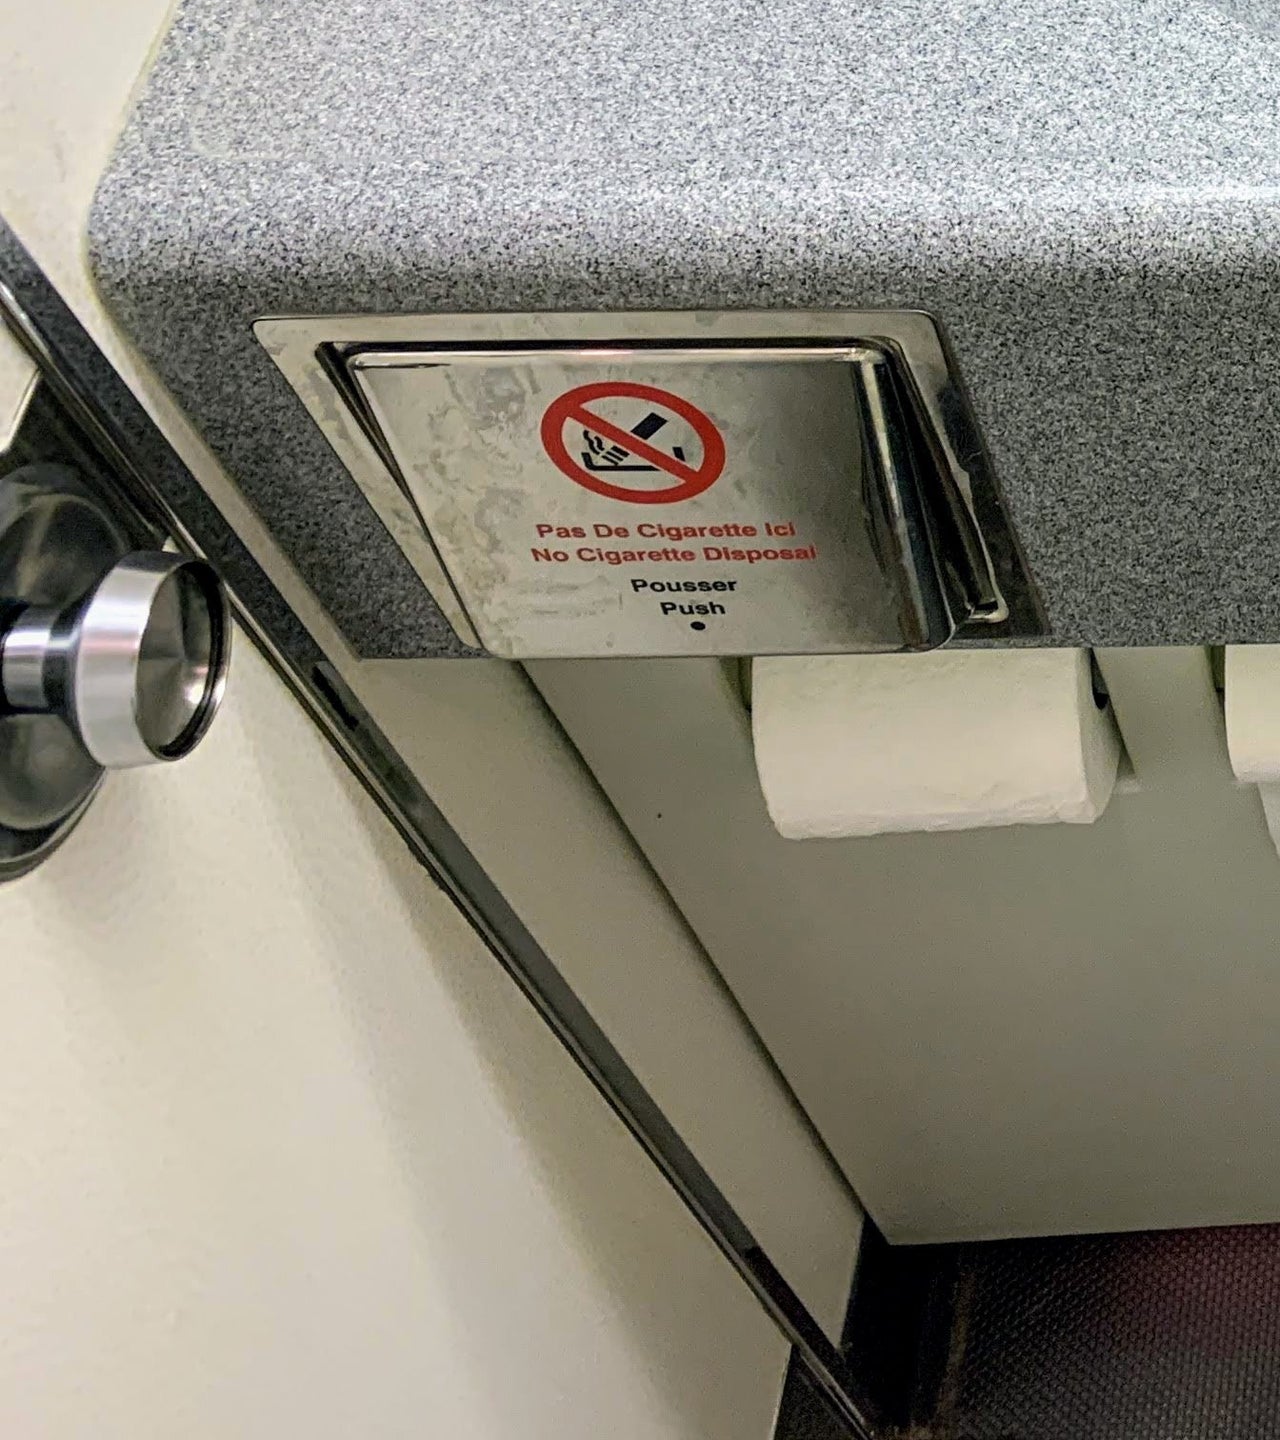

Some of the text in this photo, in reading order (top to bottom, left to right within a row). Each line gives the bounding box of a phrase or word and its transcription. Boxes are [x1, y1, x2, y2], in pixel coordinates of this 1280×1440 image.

[535, 521, 796, 541] Pas De Cigarette Ici
[530, 545, 817, 565] No Cigarette Disposal
[630, 578, 738, 593] Pousser
[659, 601, 726, 616] Push
